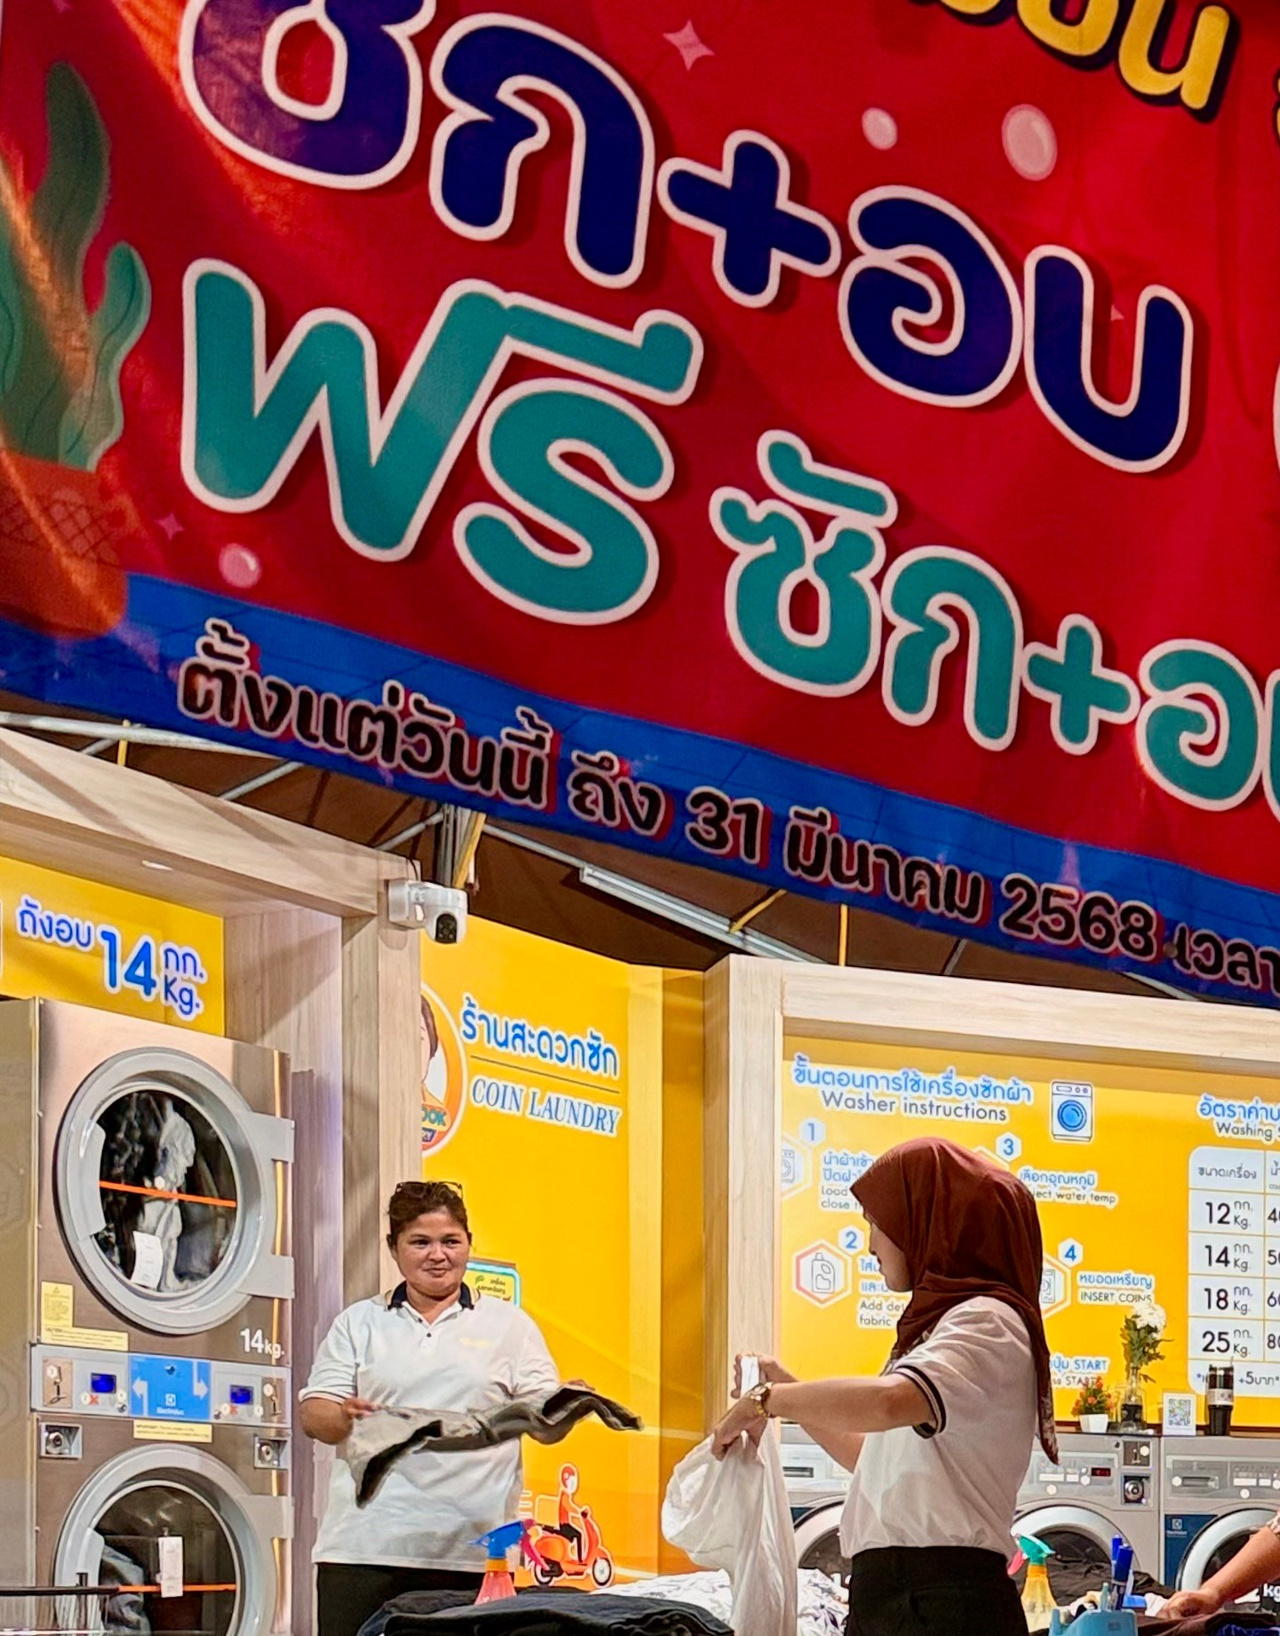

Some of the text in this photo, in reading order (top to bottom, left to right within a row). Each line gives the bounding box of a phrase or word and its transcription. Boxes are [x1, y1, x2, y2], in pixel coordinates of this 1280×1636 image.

[181, 257, 704, 627] ฟรี
[177, 619, 553, 811] ตั้งแต่วันนี้
[567, 748, 666, 836] ถึง
[685, 786, 764, 865] 31
[782, 803, 987, 924] มีนาคม
[999, 872, 1159, 963] 2568
[18, 897, 204, 997] ถังอบ 14 กก.
[163, 973, 201, 1016] Kg.
[461, 995, 619, 1078] ร้านสะดวกซัก
[793, 1054, 1032, 1103] ขั้นตอนการใช้เครื่องซักผ้า
[472, 1078, 620, 1135] COIN LAUNDRY
[821, 1089, 1007, 1122] Washer instructions
[807, 1122, 816, 1142] 1
[1215, 1121, 1273, 1141] Washing
[1003, 1137, 1014, 1156] 3
[1056, 1191, 1087, 1202] water
[1090, 1193, 1117, 1206] temp
[1205, 1201, 1231, 1225] 12
[1233, 1214, 1252, 1230] Kg.
[845, 1231, 858, 1249] 2
[1064, 1244, 1078, 1262] 4
[1204, 1244, 1231, 1268] 14
[1233, 1257, 1251, 1273] Kg.
[859, 1300, 883, 1312] Add
[1080, 1291, 1115, 1303] INSERT
[1204, 1287, 1229, 1311] 18
[1233, 1300, 1251, 1316] Kg.
[860, 1314, 892, 1327] fabric
[1201, 1330, 1230, 1354] 25
[1233, 1343, 1251, 1359] Kg.
[1074, 1359, 1107, 1371] START
